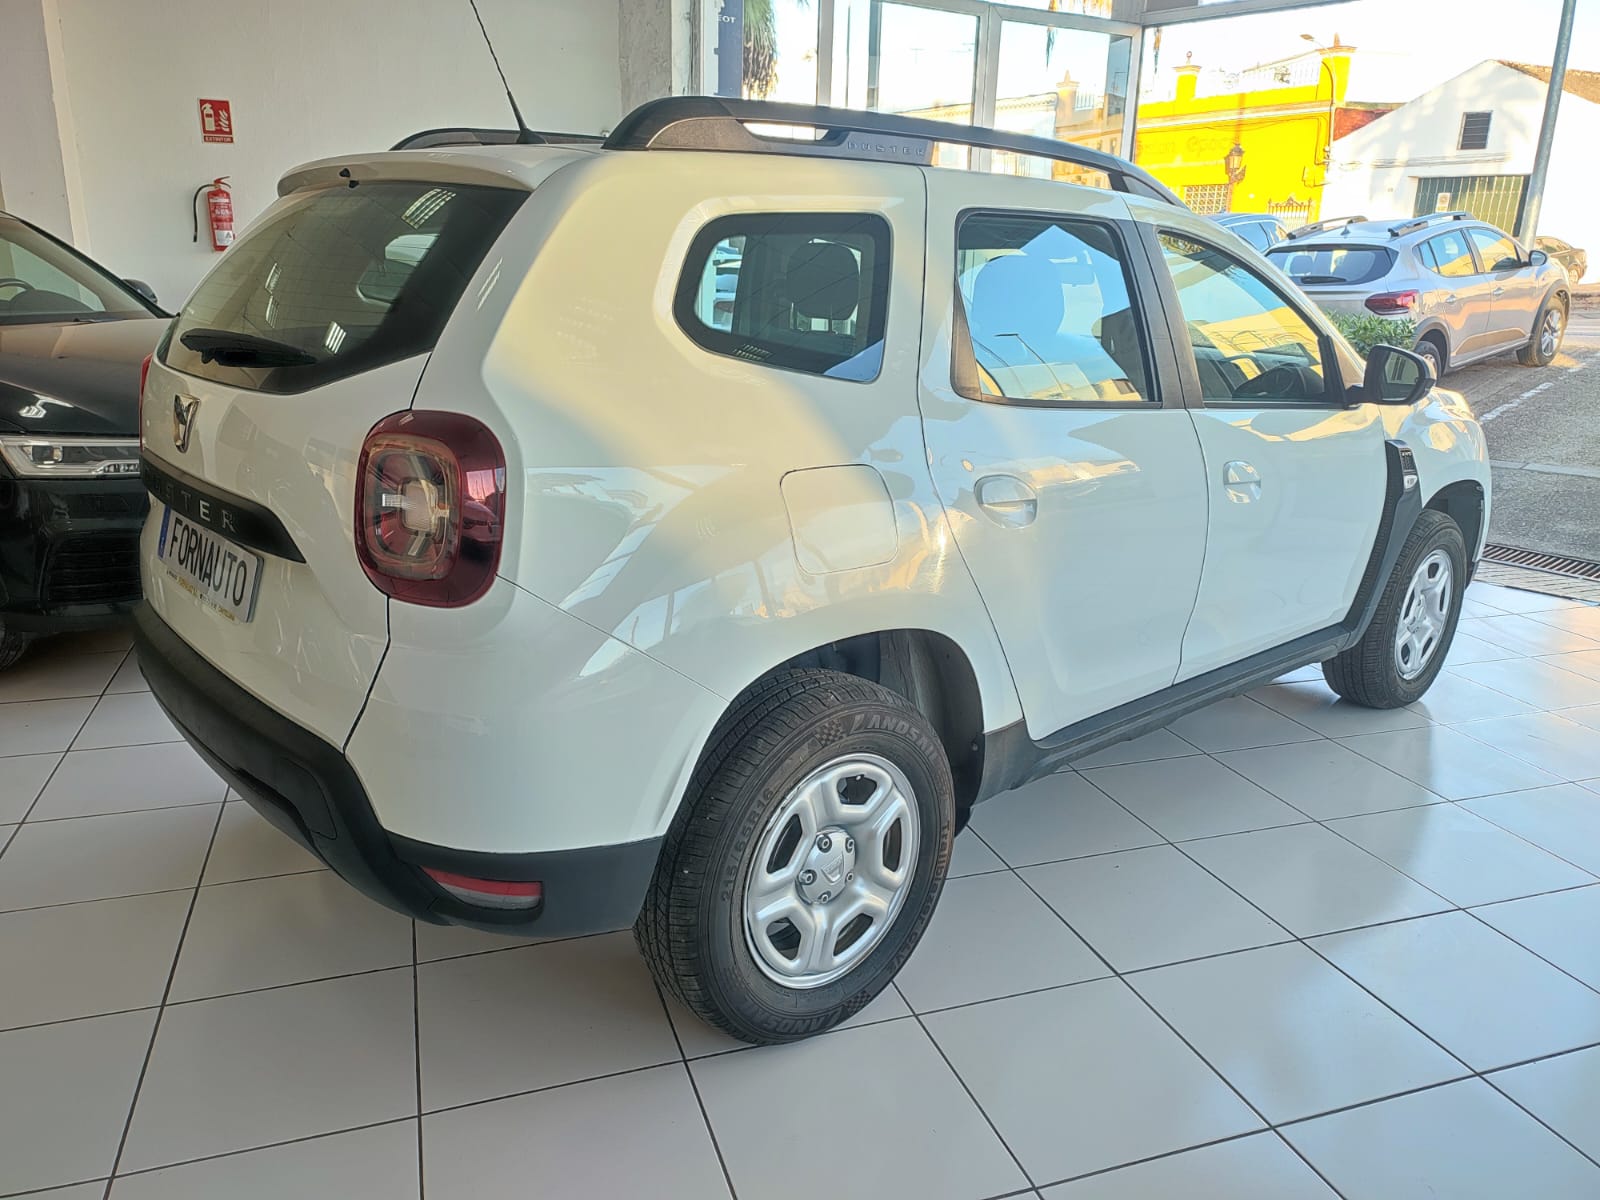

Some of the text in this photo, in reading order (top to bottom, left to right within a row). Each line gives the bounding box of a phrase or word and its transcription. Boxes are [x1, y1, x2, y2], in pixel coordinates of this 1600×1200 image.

[847, 141, 925, 156] DUSTER
[169, 517, 248, 607] FORNAUTO
[722, 788, 774, 901] 215/65R16
